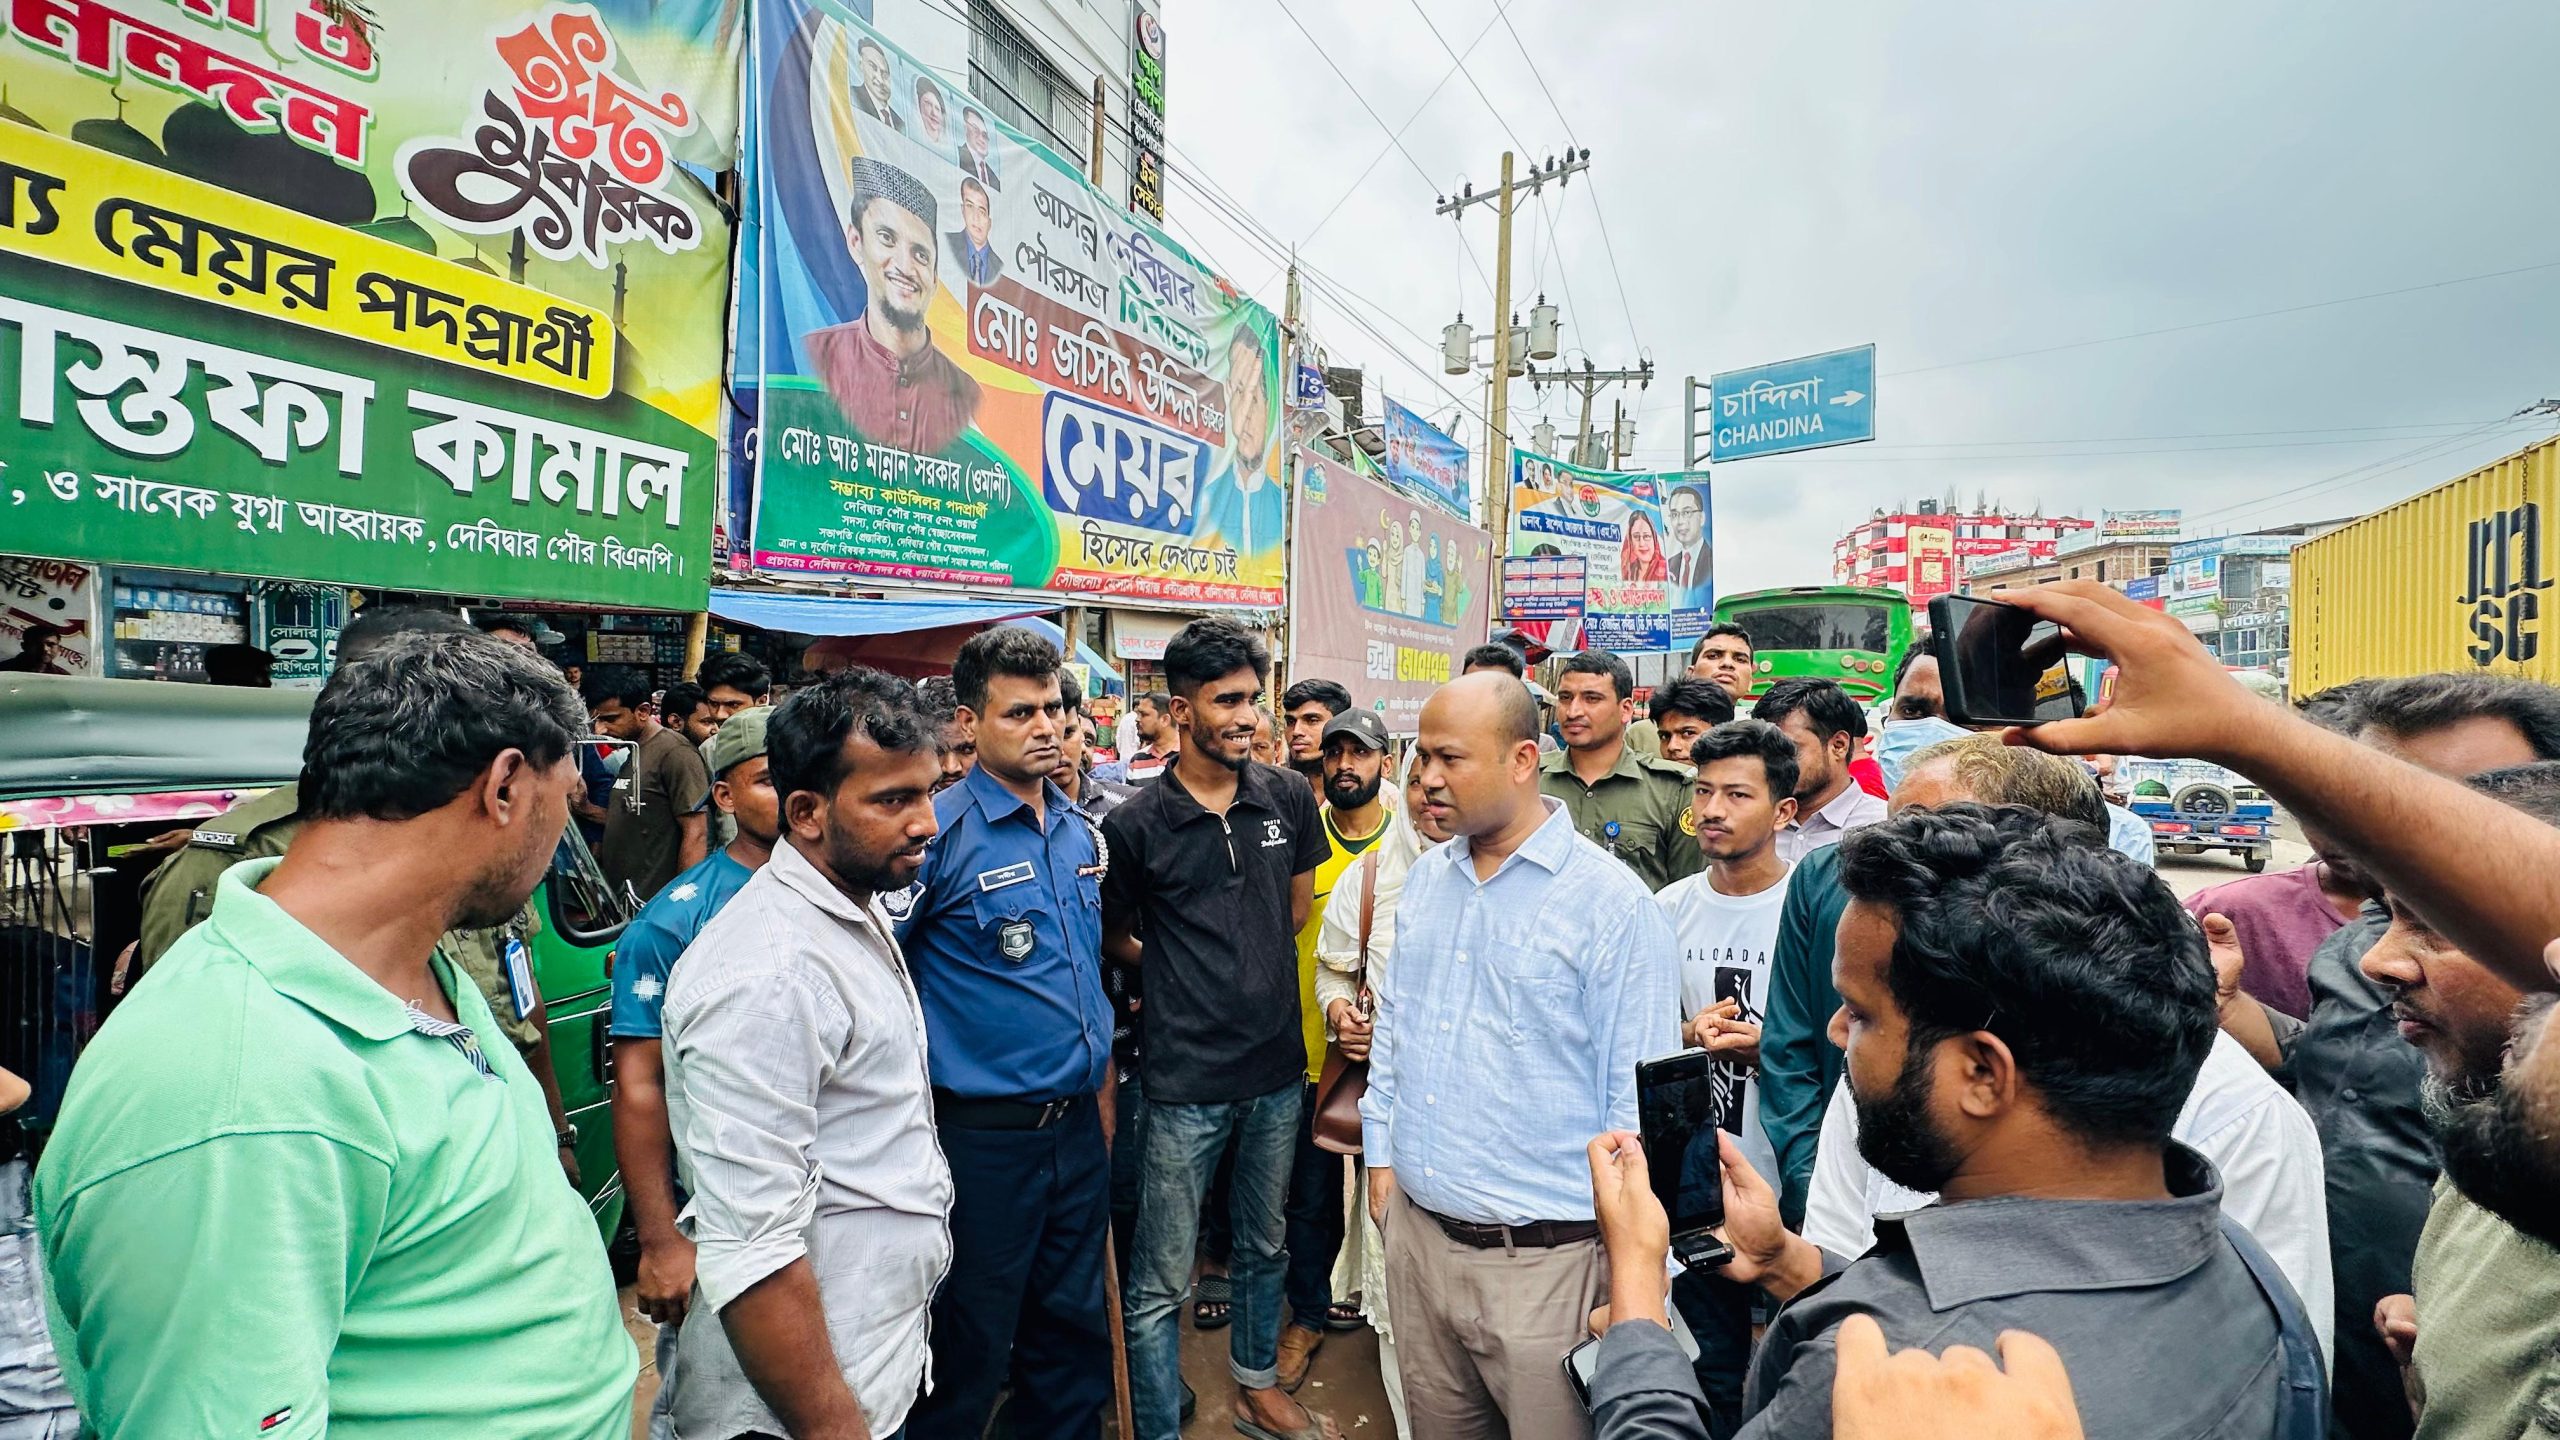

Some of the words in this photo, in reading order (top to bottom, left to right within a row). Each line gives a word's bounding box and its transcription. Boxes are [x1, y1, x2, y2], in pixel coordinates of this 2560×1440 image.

[95, 198, 336, 310] মেয়র
[356, 269, 596, 381] পদপ্রার্থী
[1016, 232, 1109, 316] পৌরসভা
[1032, 181, 1098, 262] আসন্ন
[1106, 231, 1196, 316] দেবিদ্বার
[974, 292, 1038, 367] মোঃ
[1049, 321, 1133, 403] জসিম
[1138, 352, 1200, 430] উদ্দিন
[1718, 375, 1825, 418] চান্দিনা
[407, 389, 690, 528] কামাল
[781, 426, 820, 466] মোঃ
[826, 433, 859, 473] আঃ
[864, 441, 912, 487] মান্নান
[912, 453, 962, 493] সরকার
[1045, 405, 1203, 527] মেয়র
[1718, 413, 1825, 448] CHANDINA
[44, 470, 79, 502] ও
[92, 473, 220, 520] সাবেক
[228, 492, 289, 535] যুগ্ম
[447, 518, 541, 560] দেবিদ্বার
[547, 528, 597, 566] পৌর
[1080, 519, 1154, 568] হিসেবে
[1159, 543, 1211, 574] দেখতে
[1214, 547, 1239, 581] চাই
[270, 660, 320, 673] আইপিএস
[271, 627, 319, 638] সোলার
